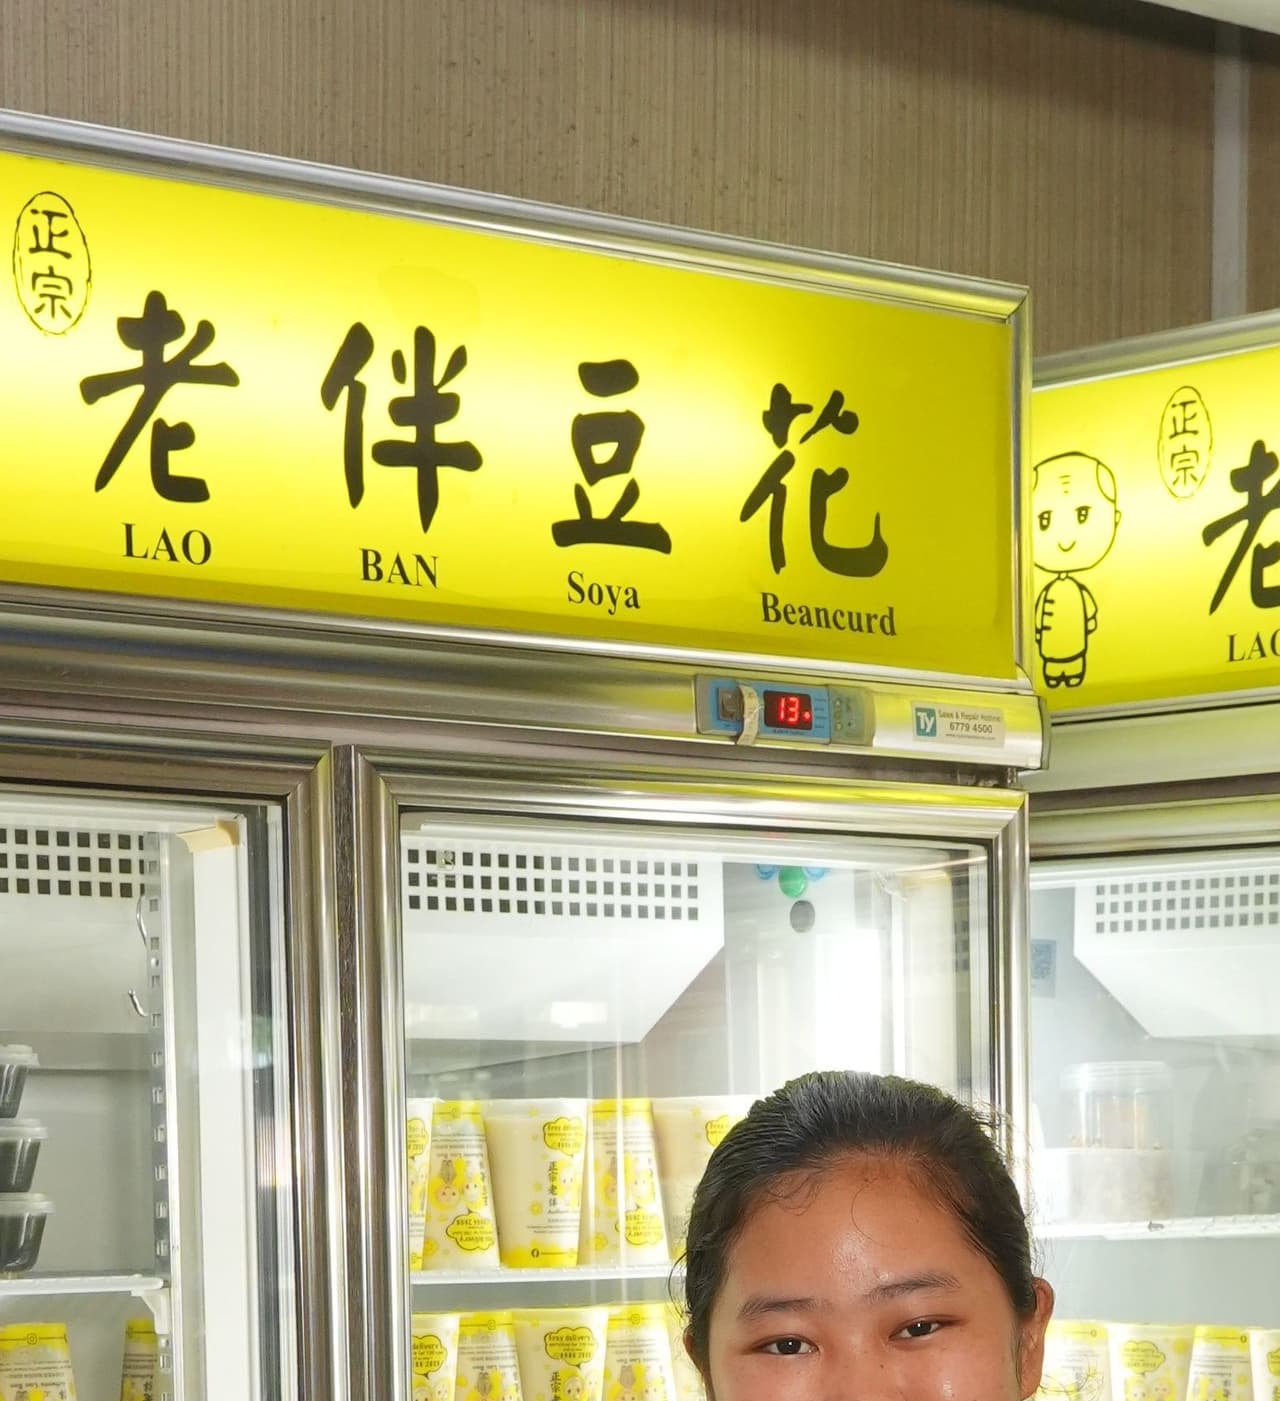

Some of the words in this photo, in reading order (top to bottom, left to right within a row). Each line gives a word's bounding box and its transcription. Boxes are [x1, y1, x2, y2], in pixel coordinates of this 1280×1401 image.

[27, 209, 78, 320] 正宗
[80, 290, 888, 578] 老伴豆花
[1166, 403, 1200, 489] 正宗
[123, 523, 212, 566] LAO
[361, 548, 439, 589] BAN
[567, 571, 641, 612] Soya
[760, 592, 897, 637] Beancurd
[949, 721, 970, 732] 6779
[972, 724, 993, 734] 4500
